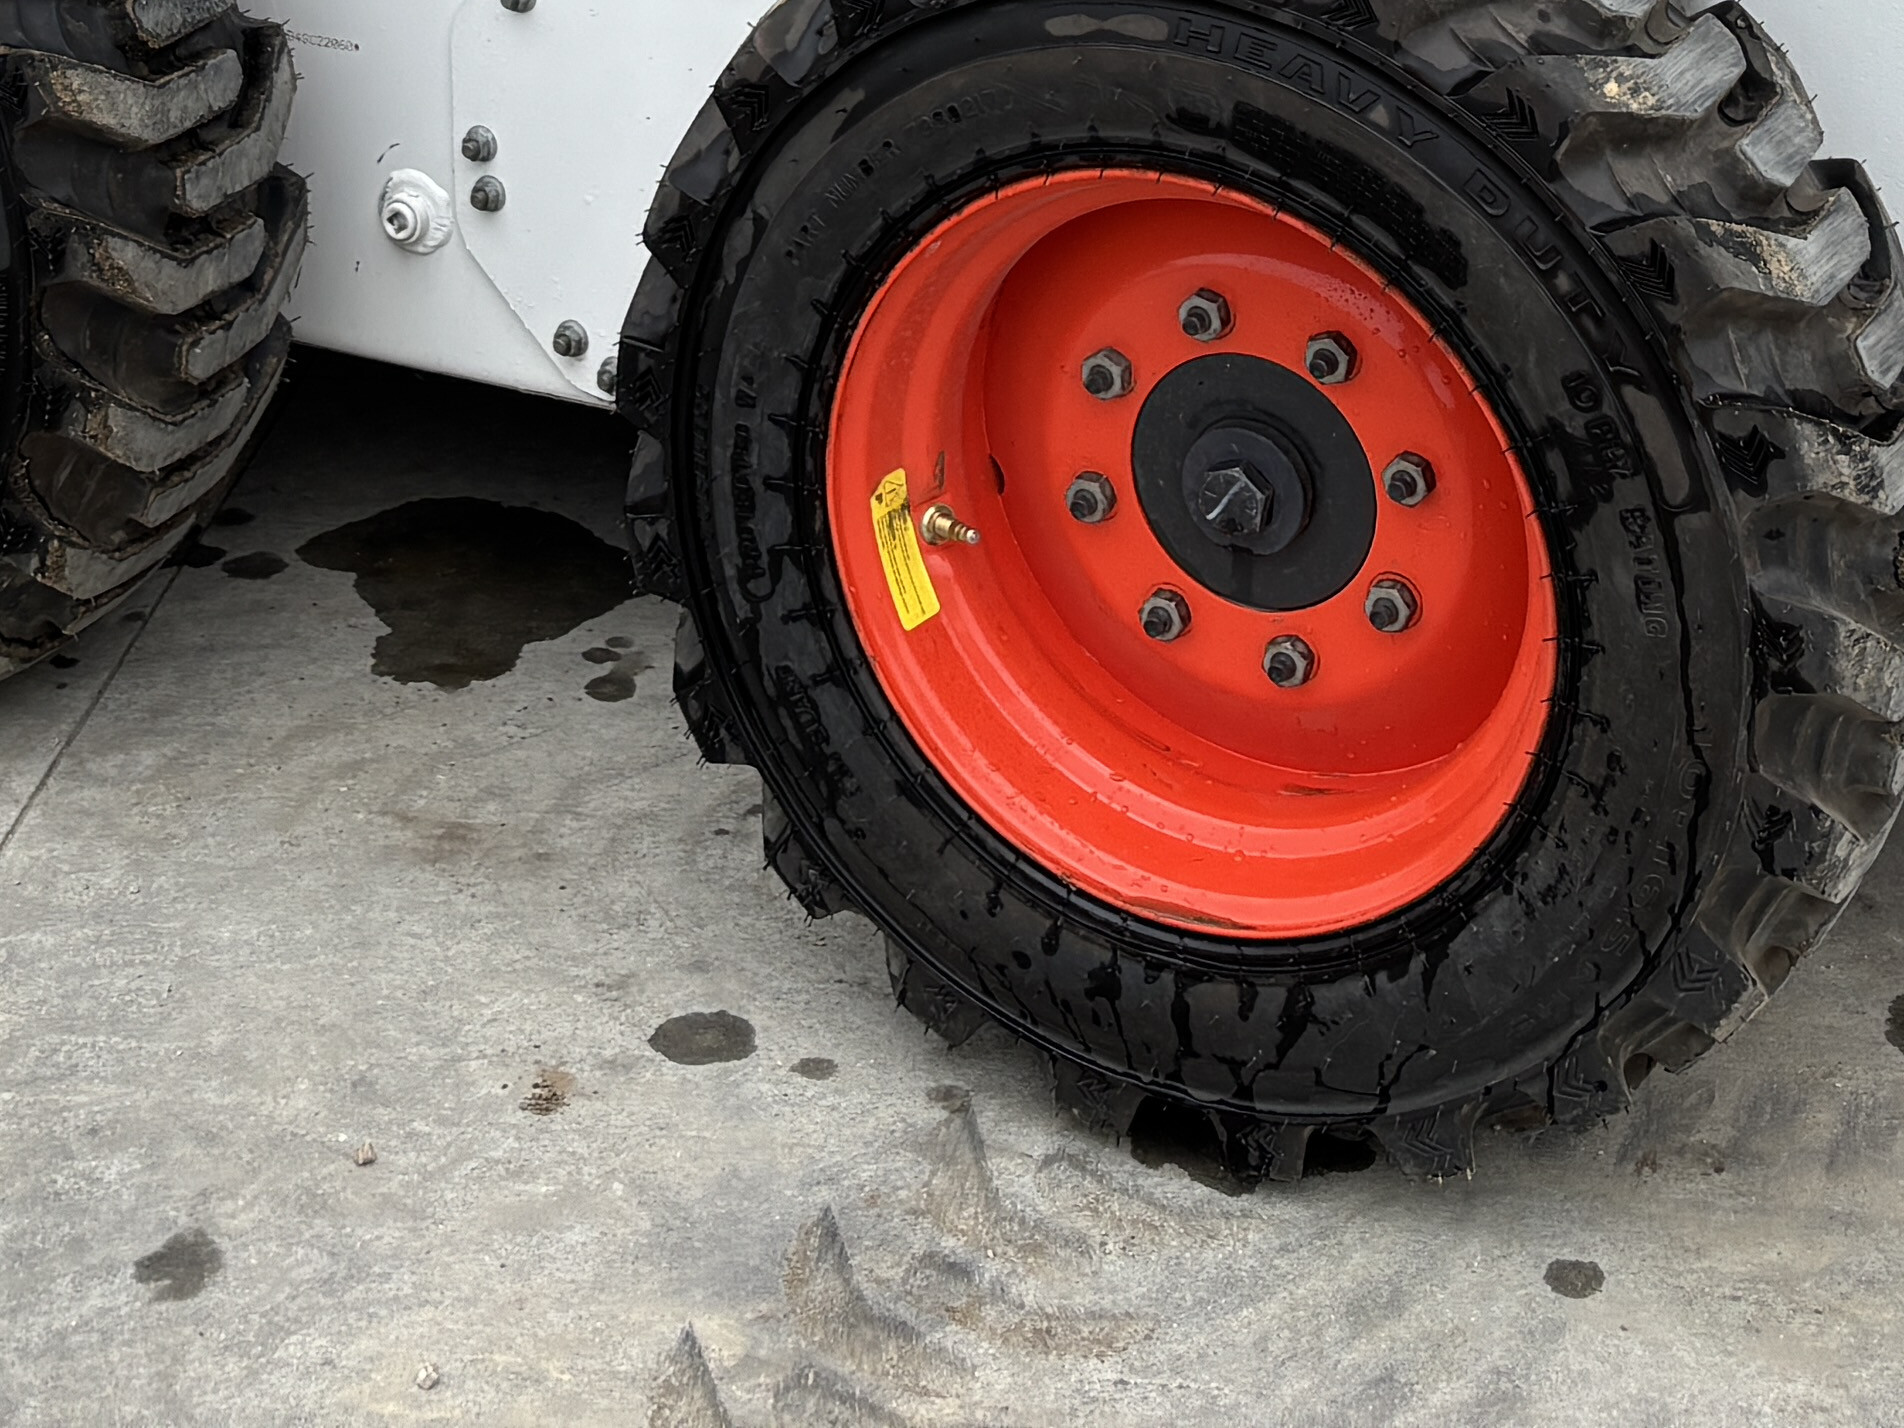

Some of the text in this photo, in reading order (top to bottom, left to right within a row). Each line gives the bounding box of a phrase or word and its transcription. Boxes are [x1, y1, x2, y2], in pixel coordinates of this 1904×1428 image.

[781, 207, 829, 268] PART
[1171, 10, 1439, 161] HEAVY
[1458, 162, 1648, 397] DUTY
[1617, 506, 1669, 639] RATING
